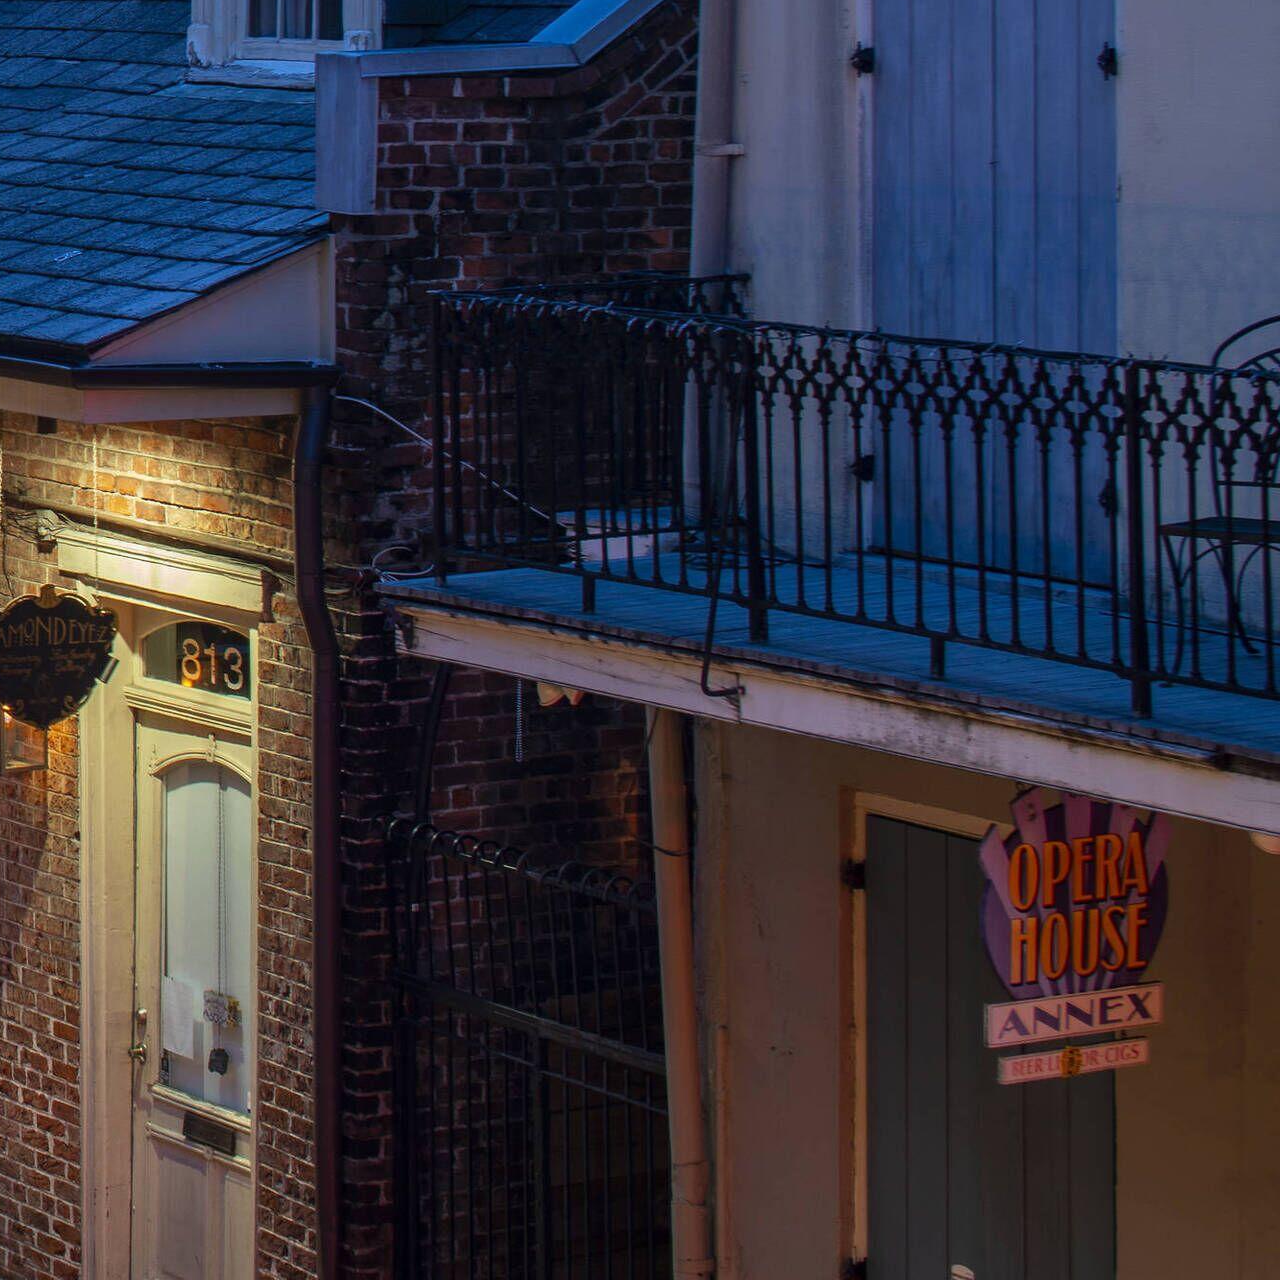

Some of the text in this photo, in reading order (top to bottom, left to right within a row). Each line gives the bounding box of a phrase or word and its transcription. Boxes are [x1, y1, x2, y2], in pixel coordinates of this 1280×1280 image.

[69, 619, 109, 644] EYEZ
[181, 638, 244, 691] 813
[1008, 831, 1150, 912] OPERA
[1009, 900, 1149, 985] HOUSE
[998, 990, 1153, 1039] ANNEX
